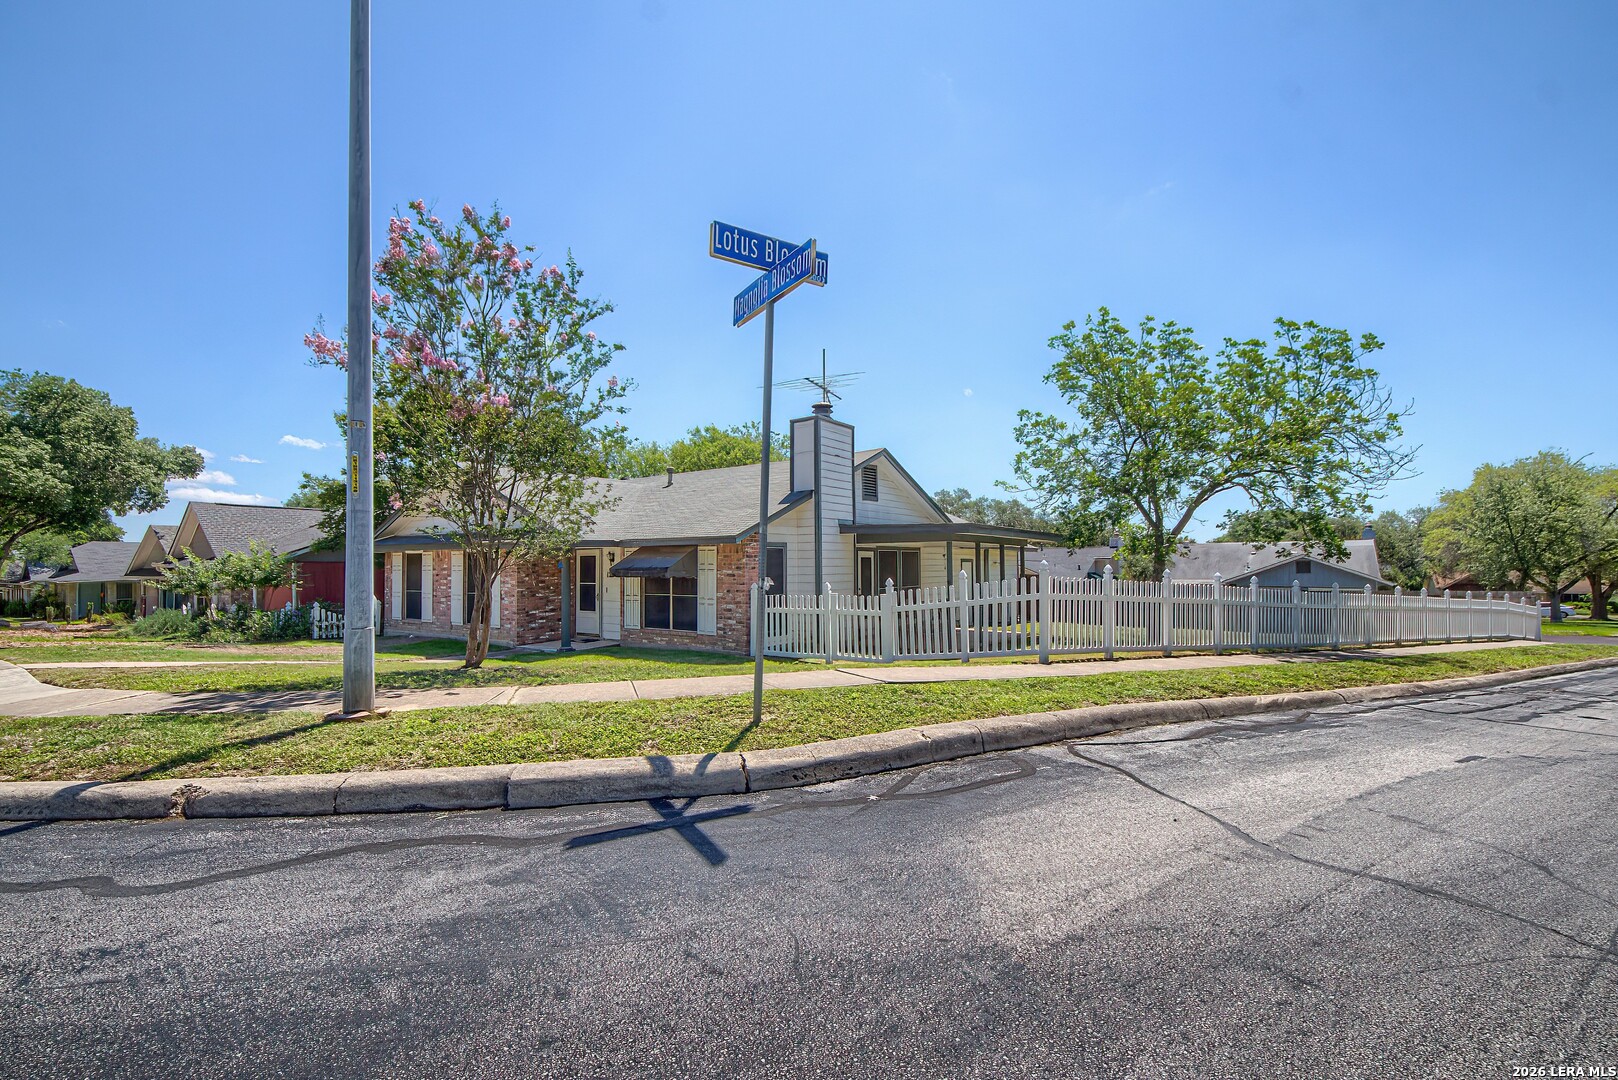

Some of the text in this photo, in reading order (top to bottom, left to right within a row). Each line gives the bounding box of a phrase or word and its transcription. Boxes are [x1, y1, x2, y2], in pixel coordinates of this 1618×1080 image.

[715, 224, 758, 258] Lotus
[734, 248, 811, 318] Magnolia Blossom
